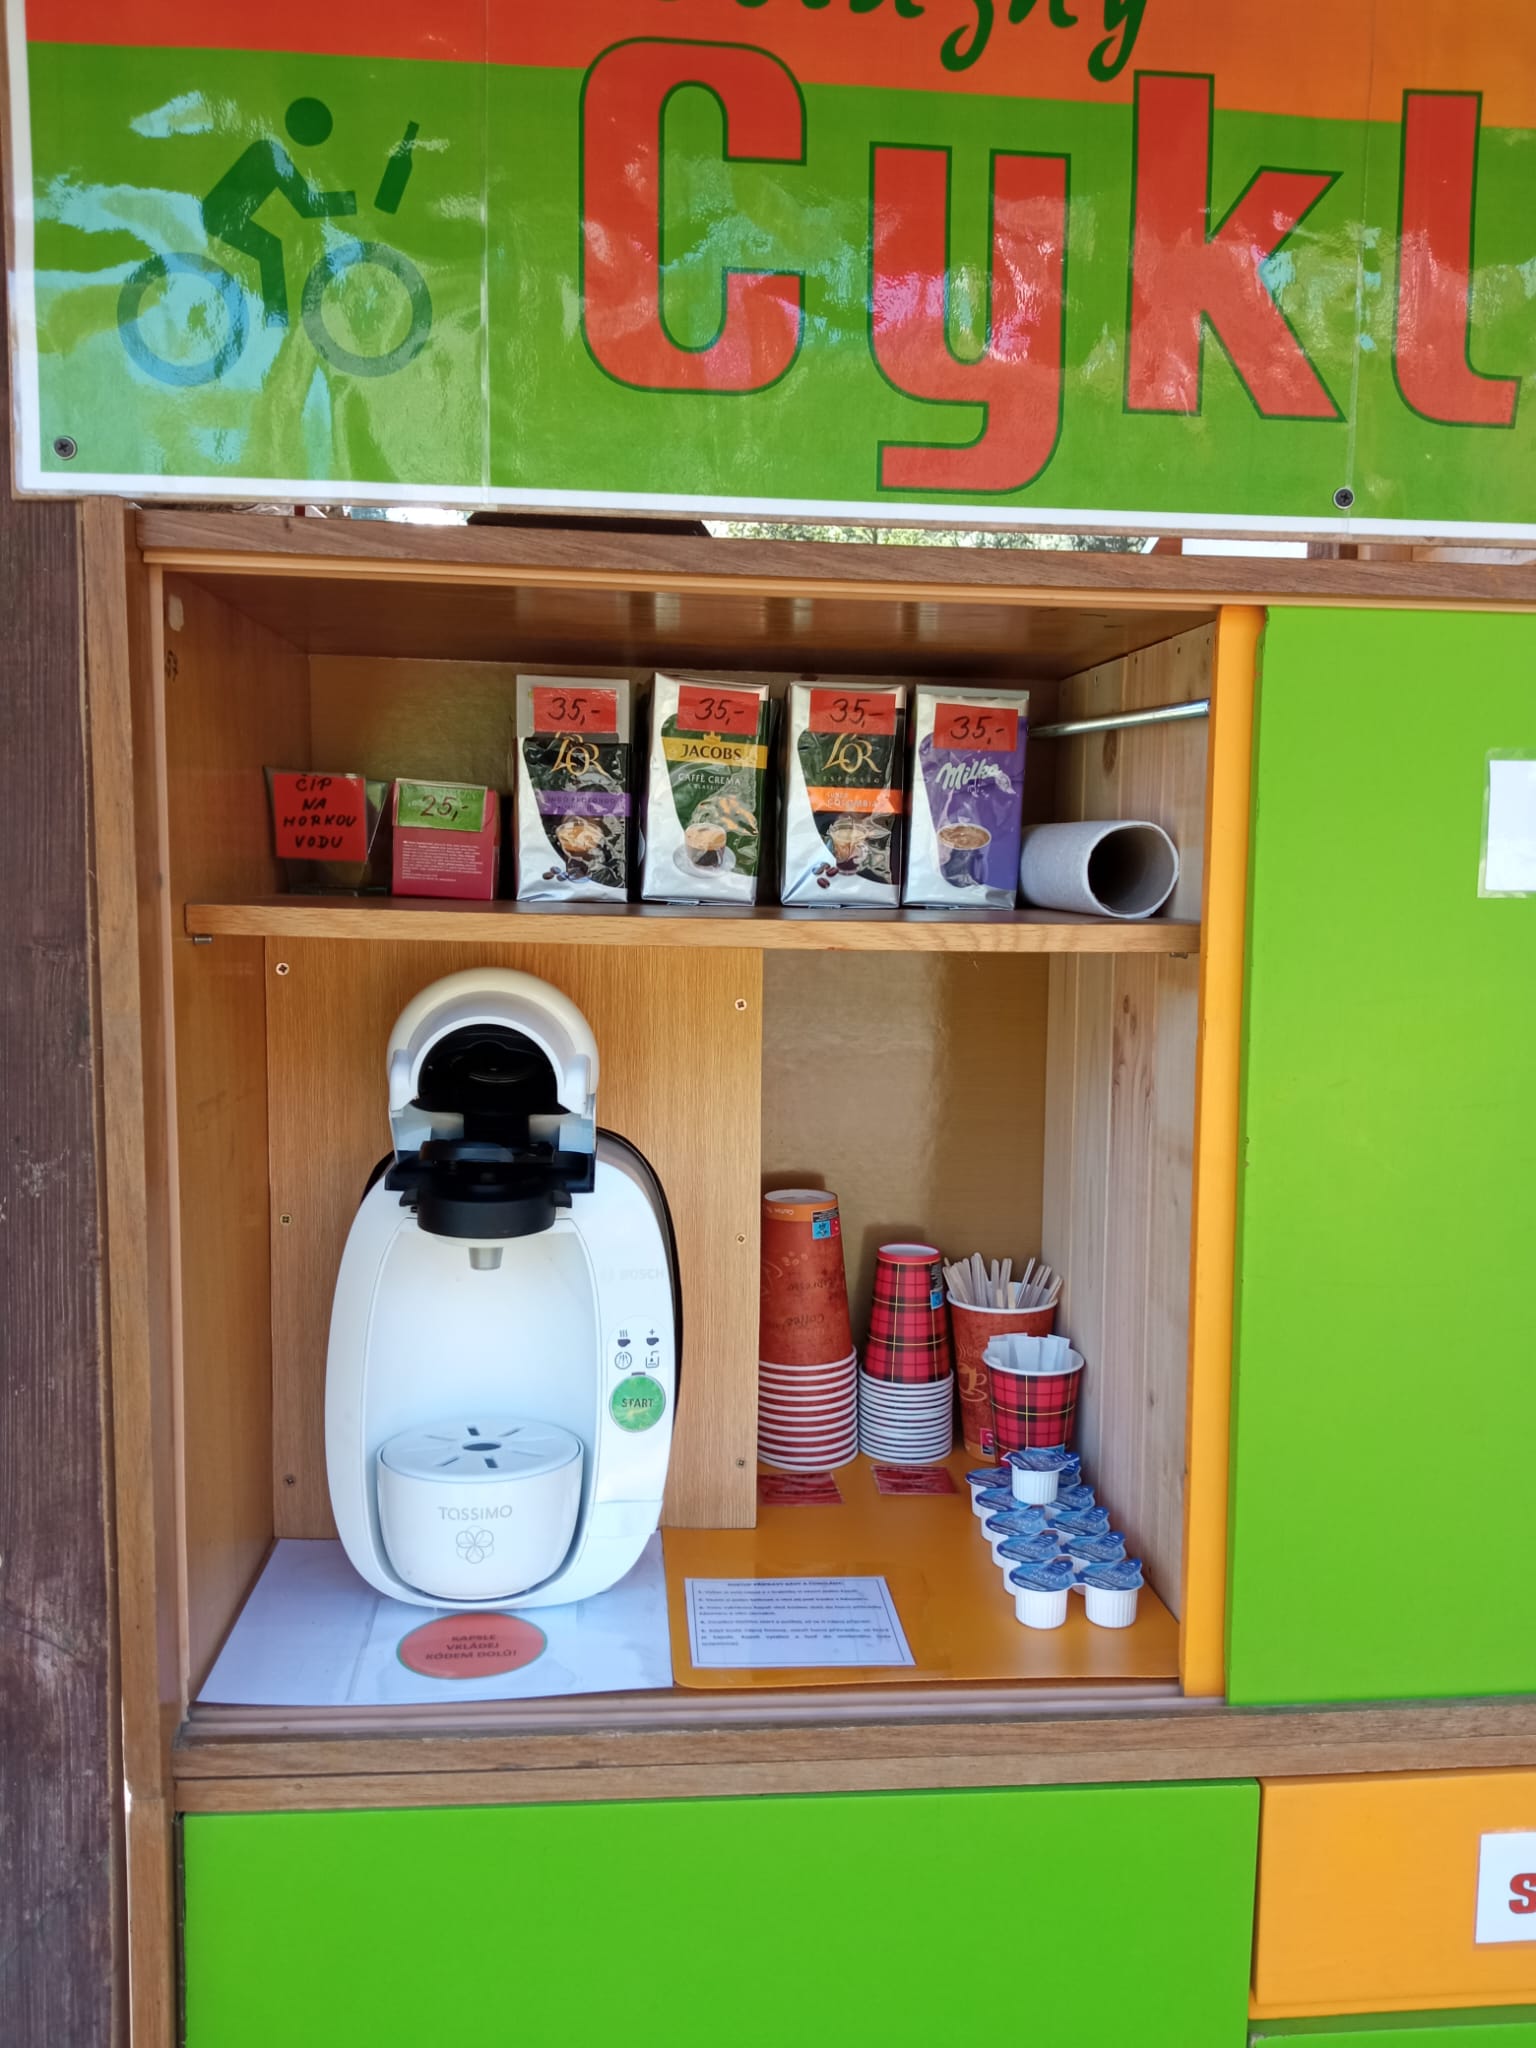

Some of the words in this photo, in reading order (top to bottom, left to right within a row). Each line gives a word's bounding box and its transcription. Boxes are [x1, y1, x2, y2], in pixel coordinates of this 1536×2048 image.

[547, 697, 600, 726] 35,-
[694, 698, 744, 726] 35,-
[829, 698, 884, 729] 35,-
[950, 716, 1005, 745] 35,-
[680, 743, 742, 760] JACOBS
[935, 758, 1000, 790] Milka
[302, 797, 327, 811] NA
[420, 794, 469, 821] 25,-
[282, 814, 357, 828] HORKOU
[295, 835, 343, 849] VODU
[622, 1398, 654, 1408] START
